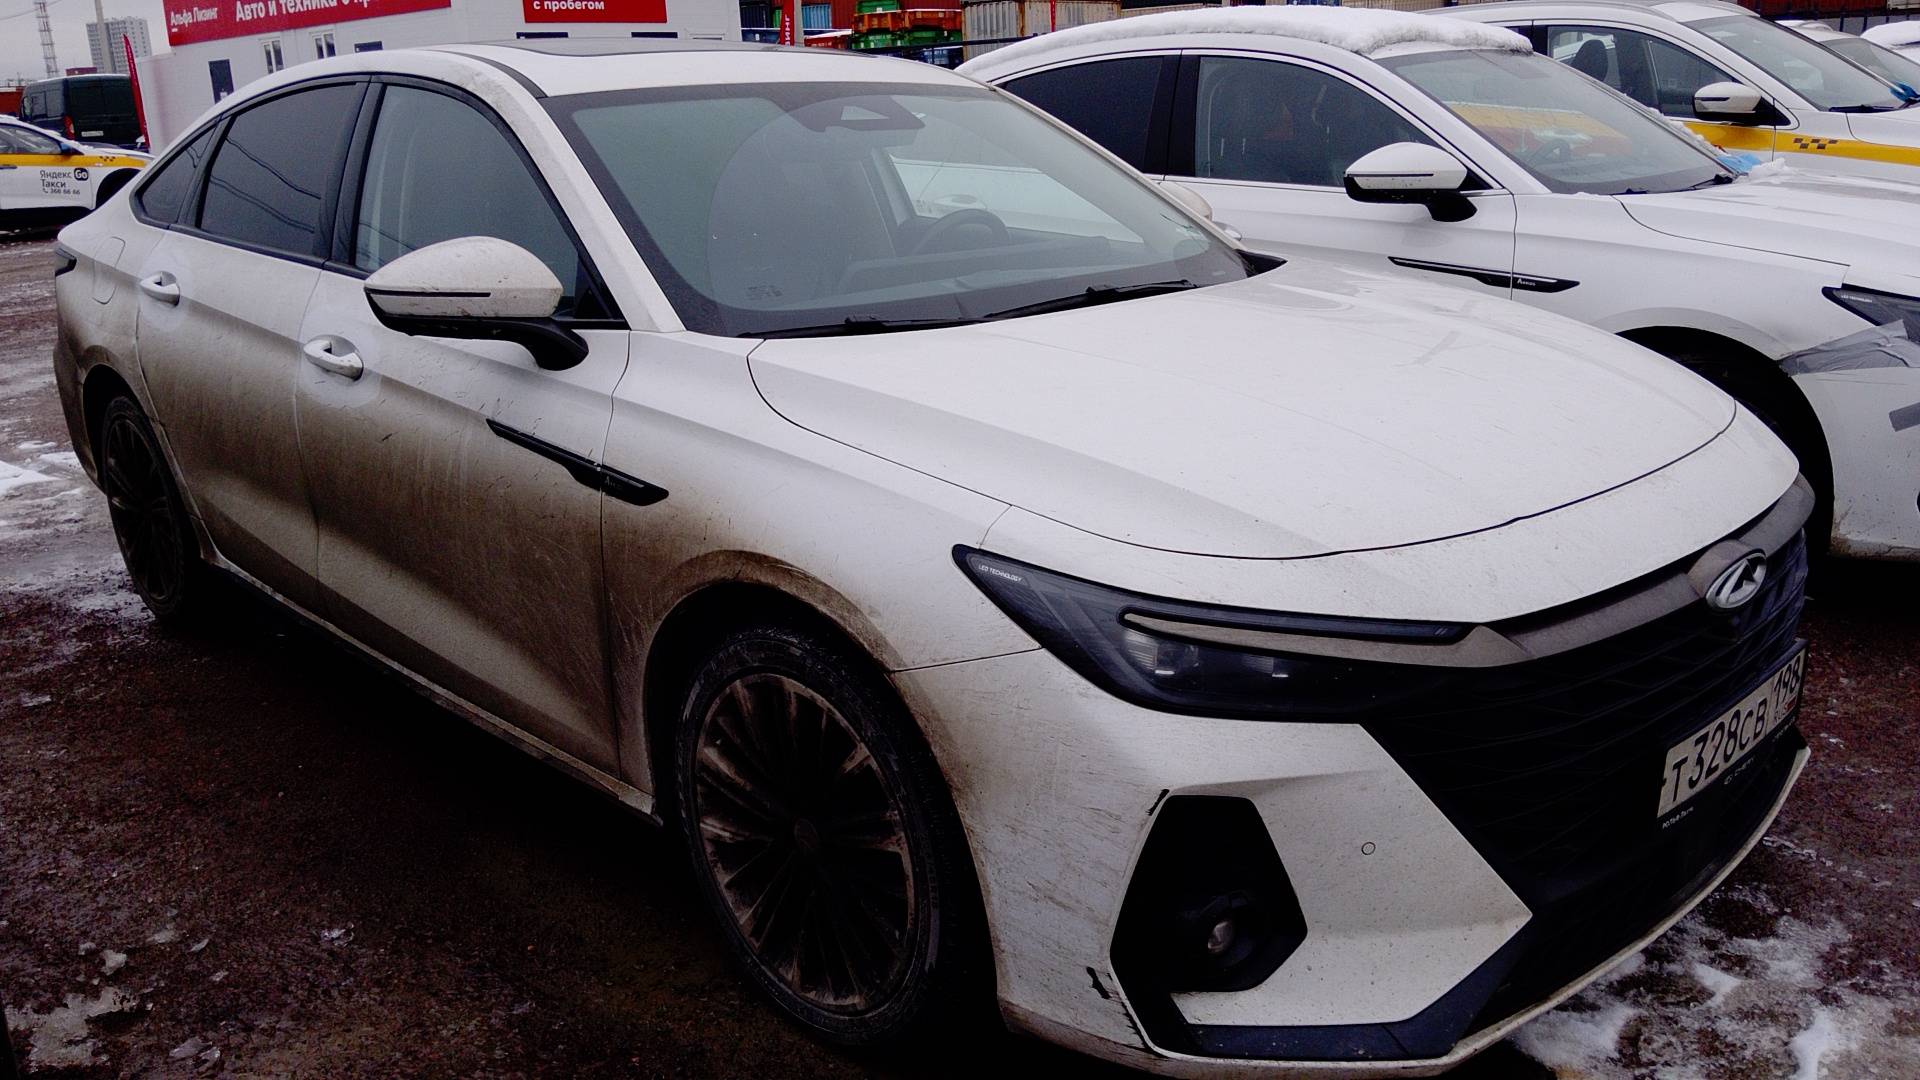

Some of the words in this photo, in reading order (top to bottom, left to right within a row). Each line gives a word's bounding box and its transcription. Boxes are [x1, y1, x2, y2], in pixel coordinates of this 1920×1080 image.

[236, 0, 265, 22] Авто
[268, 0, 277, 16] и
[533, 0, 541, 10] с
[544, 0, 605, 12] пробегом
[171, 11, 192, 27] Альфа
[193, 7, 218, 22] Лизинг
[40, 170, 73, 179] Яндекс
[75, 169, 88, 179] Go
[41, 179, 66, 187] Такси
[978, 564, 989, 572] LED
[989, 567, 1022, 581] TECHNOLOGY
[1773, 655, 1800, 710] 198
